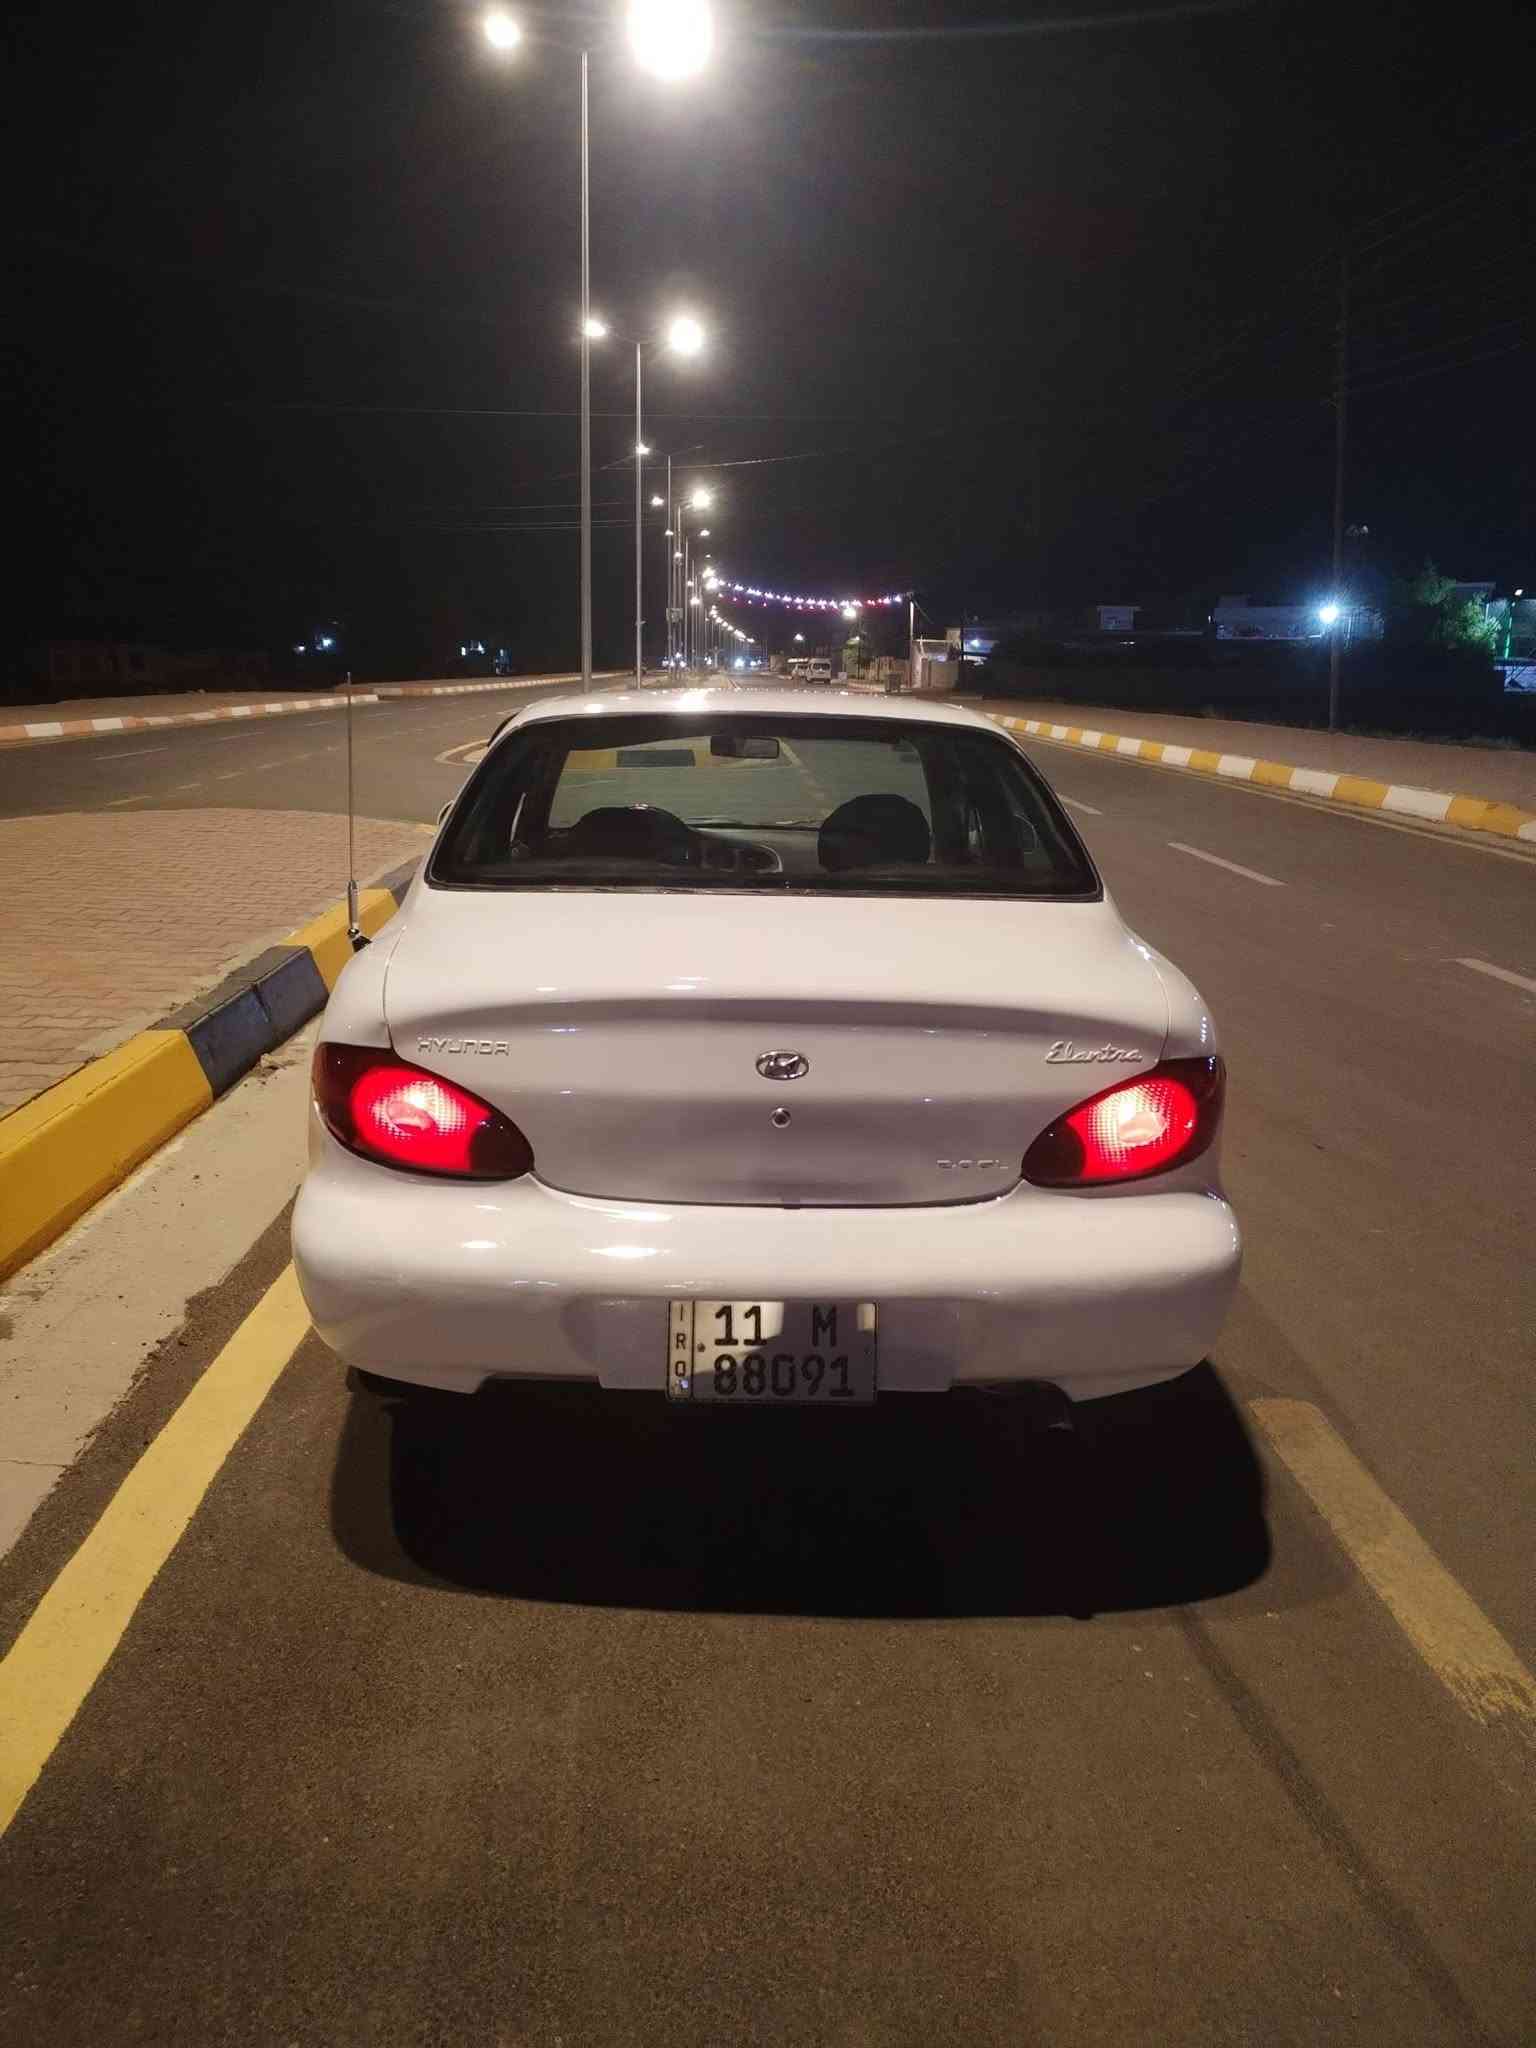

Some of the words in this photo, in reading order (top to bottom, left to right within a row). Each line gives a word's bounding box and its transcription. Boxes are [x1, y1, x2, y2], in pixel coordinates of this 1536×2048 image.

[1045, 1040, 1143, 1064] Elantra
[714, 1305, 768, 1346] 11
[811, 1304, 838, 1348] M
[713, 1354, 855, 1397] 88091
